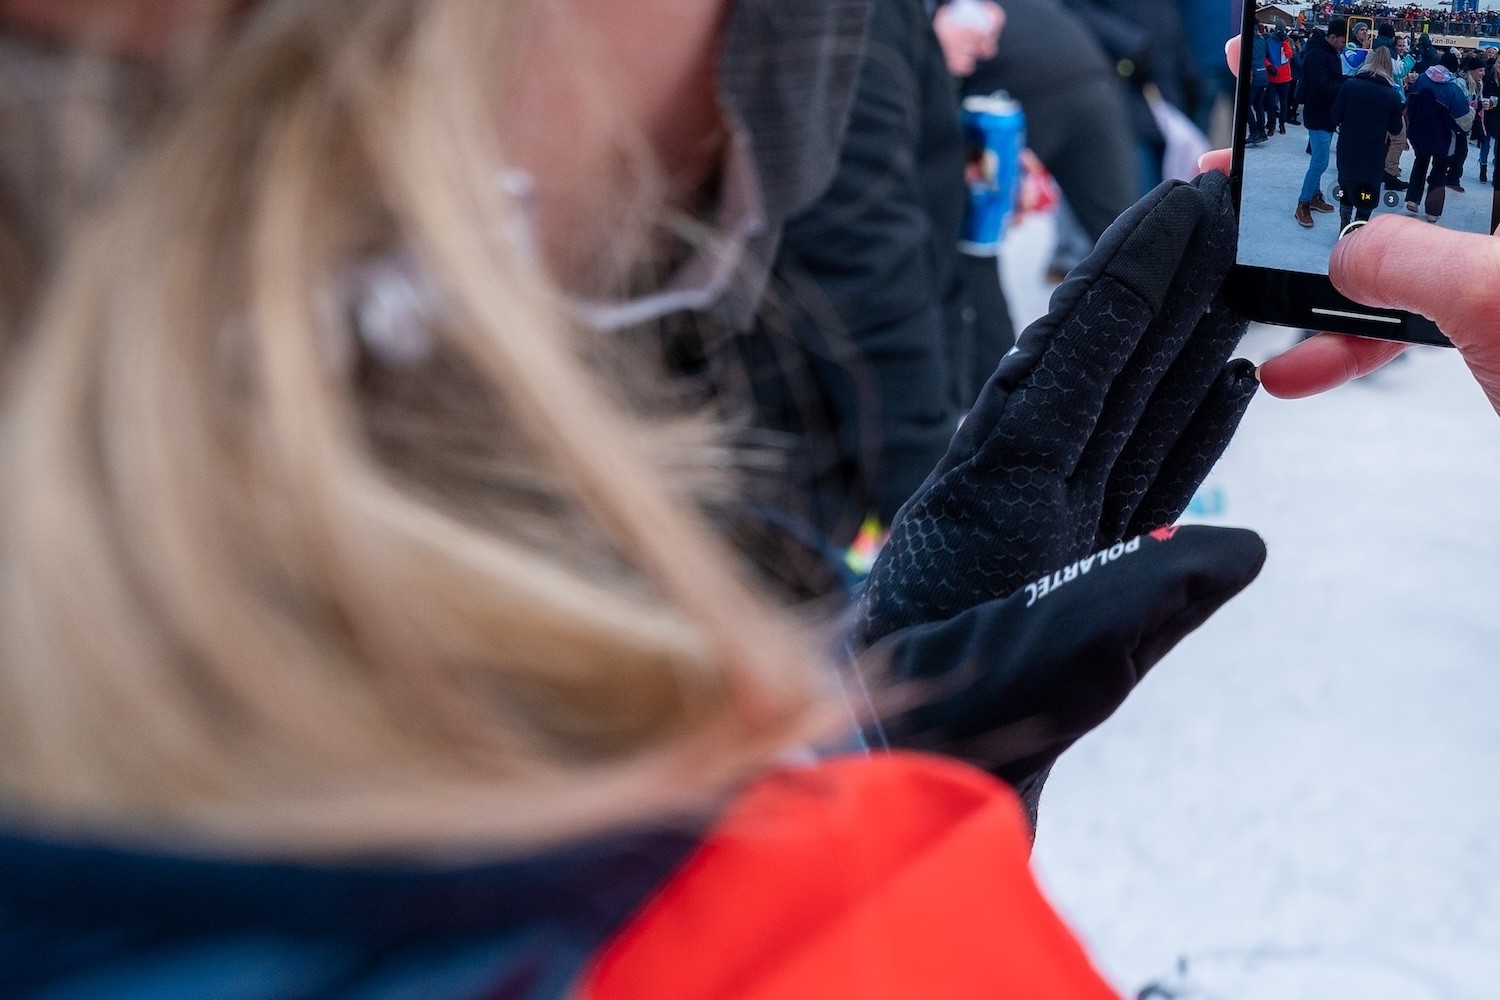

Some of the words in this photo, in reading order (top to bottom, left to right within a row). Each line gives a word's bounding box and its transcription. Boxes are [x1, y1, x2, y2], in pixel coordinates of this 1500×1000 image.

[1336, 190, 1344, 198] .5
[1388, 195, 1394, 203] 3
[1025, 535, 1141, 608] POLARTEC
